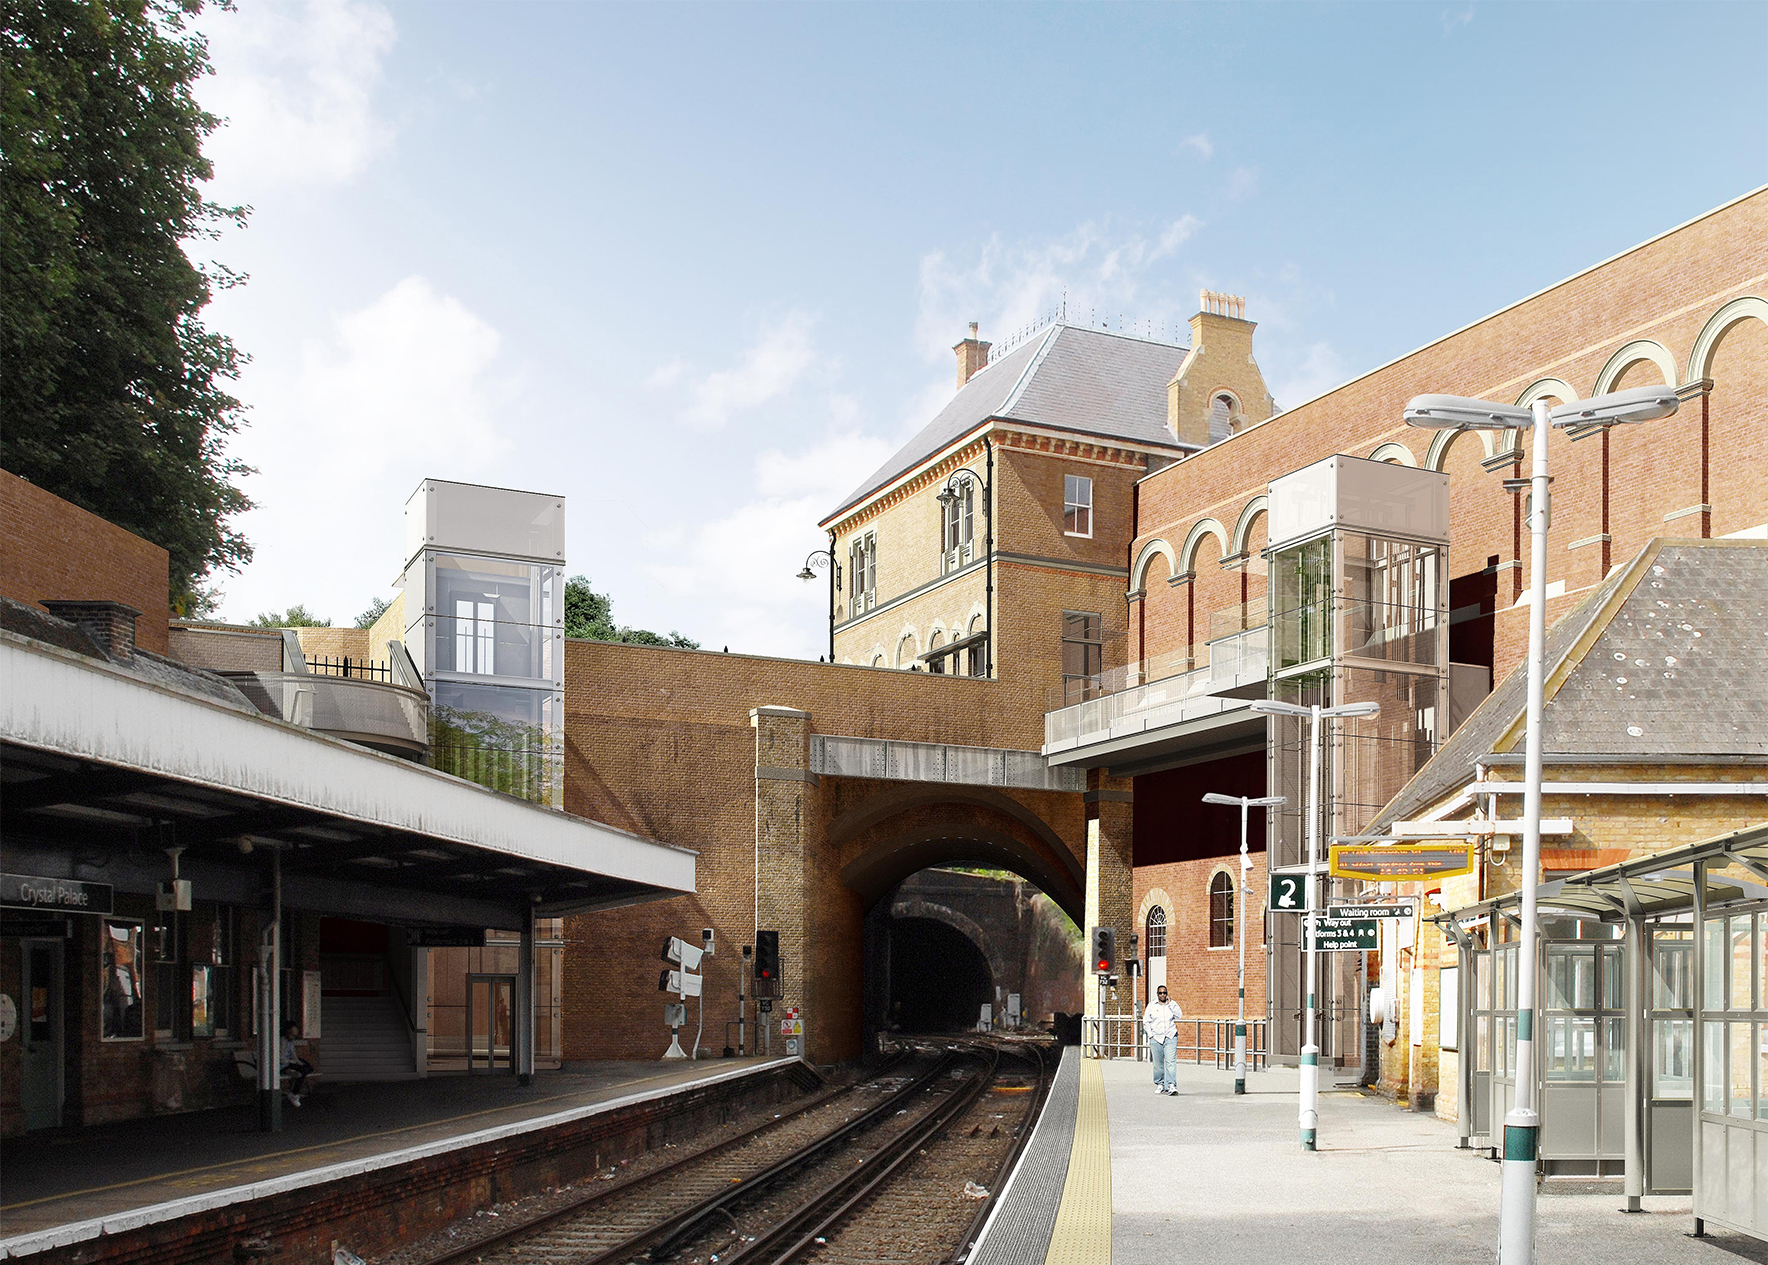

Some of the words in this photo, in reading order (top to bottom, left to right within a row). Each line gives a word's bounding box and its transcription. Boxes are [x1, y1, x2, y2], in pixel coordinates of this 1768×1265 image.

[20, 883, 56, 906] Crystal
[58, 887, 89, 905] Palace
[1280, 879, 1296, 905] 2
[1340, 908, 1369, 918] Waiting
[1323, 919, 1339, 928] Way
[1340, 919, 1352, 927] out
[1337, 929, 1342, 938] 3
[1343, 929, 1348, 938] &
[1349, 929, 1354, 938] 4
[1323, 941, 1339, 950] Help
[1340, 941, 1358, 950] point
